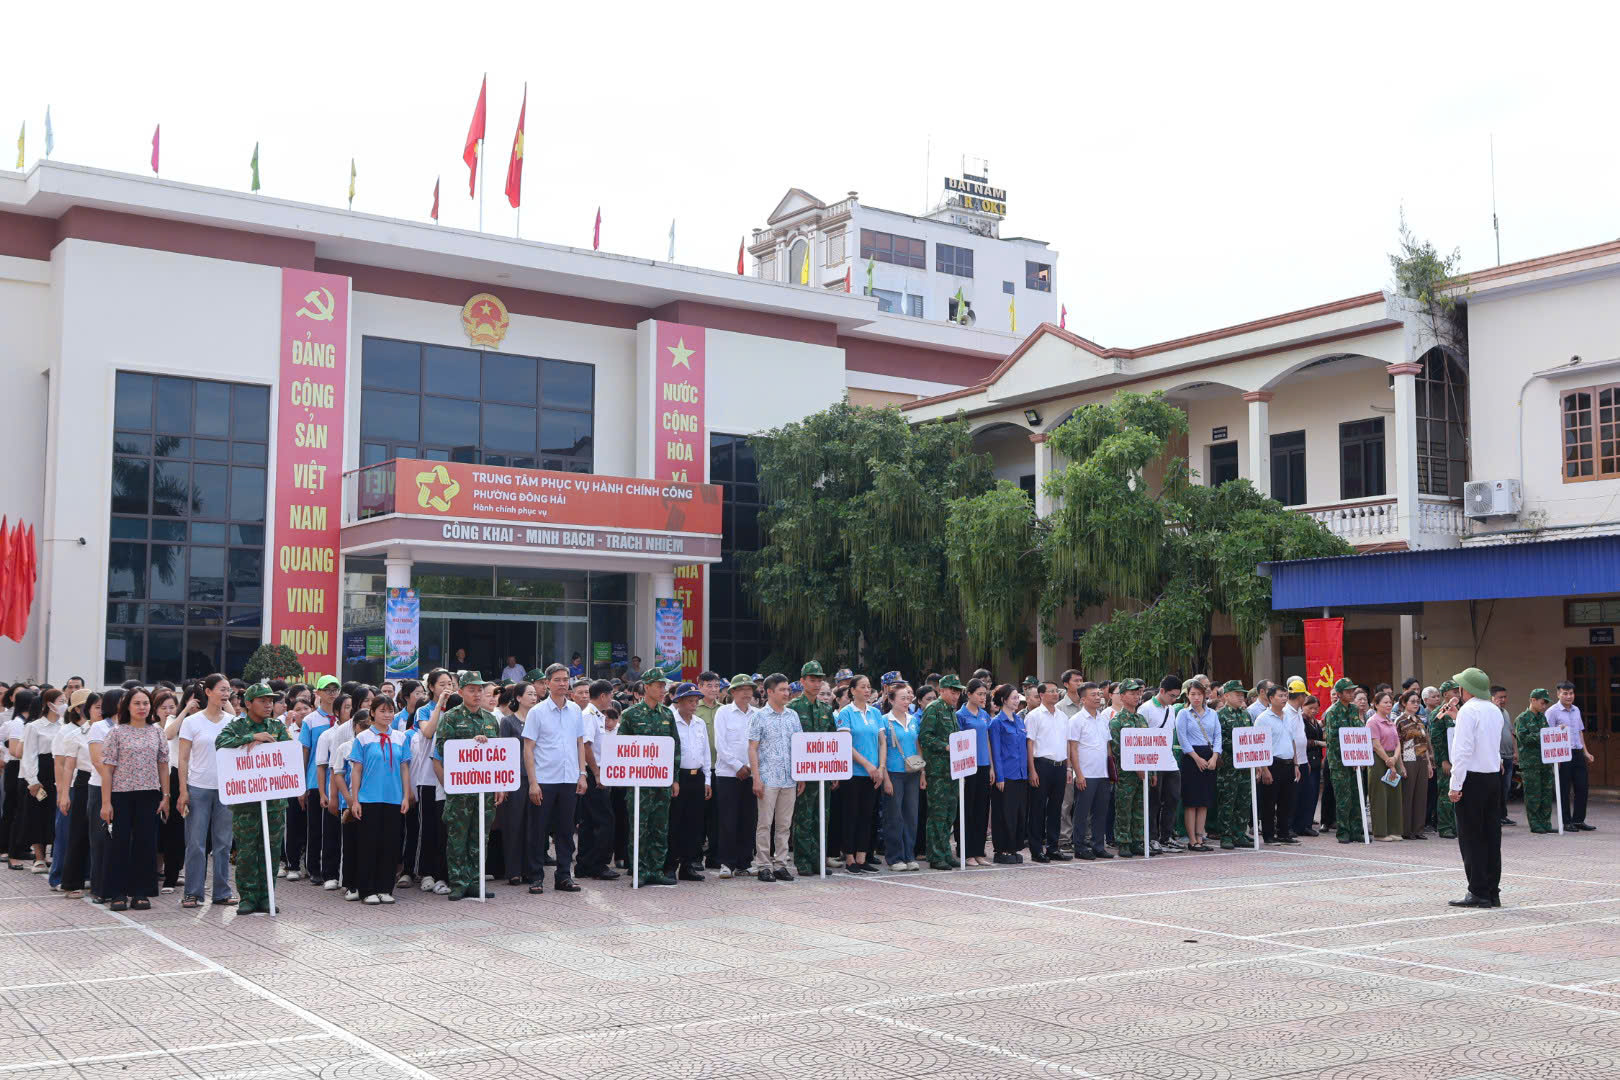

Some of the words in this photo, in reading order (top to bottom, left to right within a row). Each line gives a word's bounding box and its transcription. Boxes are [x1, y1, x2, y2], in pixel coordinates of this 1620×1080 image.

[974, 183, 1004, 199] NAM
[292, 331, 336, 368] ĐẢNG
[291, 377, 335, 412] CỘNG
[663, 380, 699, 404] NƯỚC
[295, 413, 328, 449] SẢN
[663, 409, 698, 435] CỘNG
[667, 438, 694, 462] HÒA
[293, 459, 327, 495] VIỆT
[472, 472, 512, 485] TRUNG
[515, 474, 539, 487] TÂM
[541, 477, 572, 492] PHỤC
[574, 480, 590, 494] VỤ
[592, 480, 624, 494] HÀNH
[625, 483, 660, 497] CHÍNH
[661, 485, 693, 499] CÔNG
[473, 488, 517, 501] PHƯỜNG
[519, 491, 548, 504] ĐÔNG
[550, 493, 566, 505] HẢI
[289, 504, 327, 531] NAM
[473, 503, 494, 512] Hành
[495, 505, 517, 514] chính
[517, 506, 537, 517] phục
[538, 509, 548, 517] vụ
[442, 521, 479, 540] CÔNG
[482, 526, 514, 543] KHAI
[526, 528, 560, 545] MINH
[562, 531, 595, 549] BẠCH
[605, 532, 642, 550] TRÁCH
[645, 535, 684, 554] NHIỆM
[279, 545, 334, 573] QUANG
[287, 587, 325, 614] VINH
[458, 744, 483, 762] KHỐI
[486, 745, 506, 762] CÁC
[617, 740, 640, 758] KHỐI
[643, 742, 659, 761] HỘI
[806, 737, 824, 753] KHỐI
[826, 738, 839, 755] HỘI
[236, 752, 255, 771] KHỐI
[255, 750, 271, 769] CÁN
[606, 765, 626, 779] CCB
[629, 762, 669, 779] PHƯỜNG
[796, 761, 816, 774] LHPN
[818, 757, 848, 773] PHƯỜNG
[225, 778, 246, 796] CÔNG
[247, 774, 268, 793] CHỨC
[269, 771, 299, 791] PHƯỜNG
[450, 767, 492, 786] TRƯỜNG
[494, 769, 515, 787] HỌC
